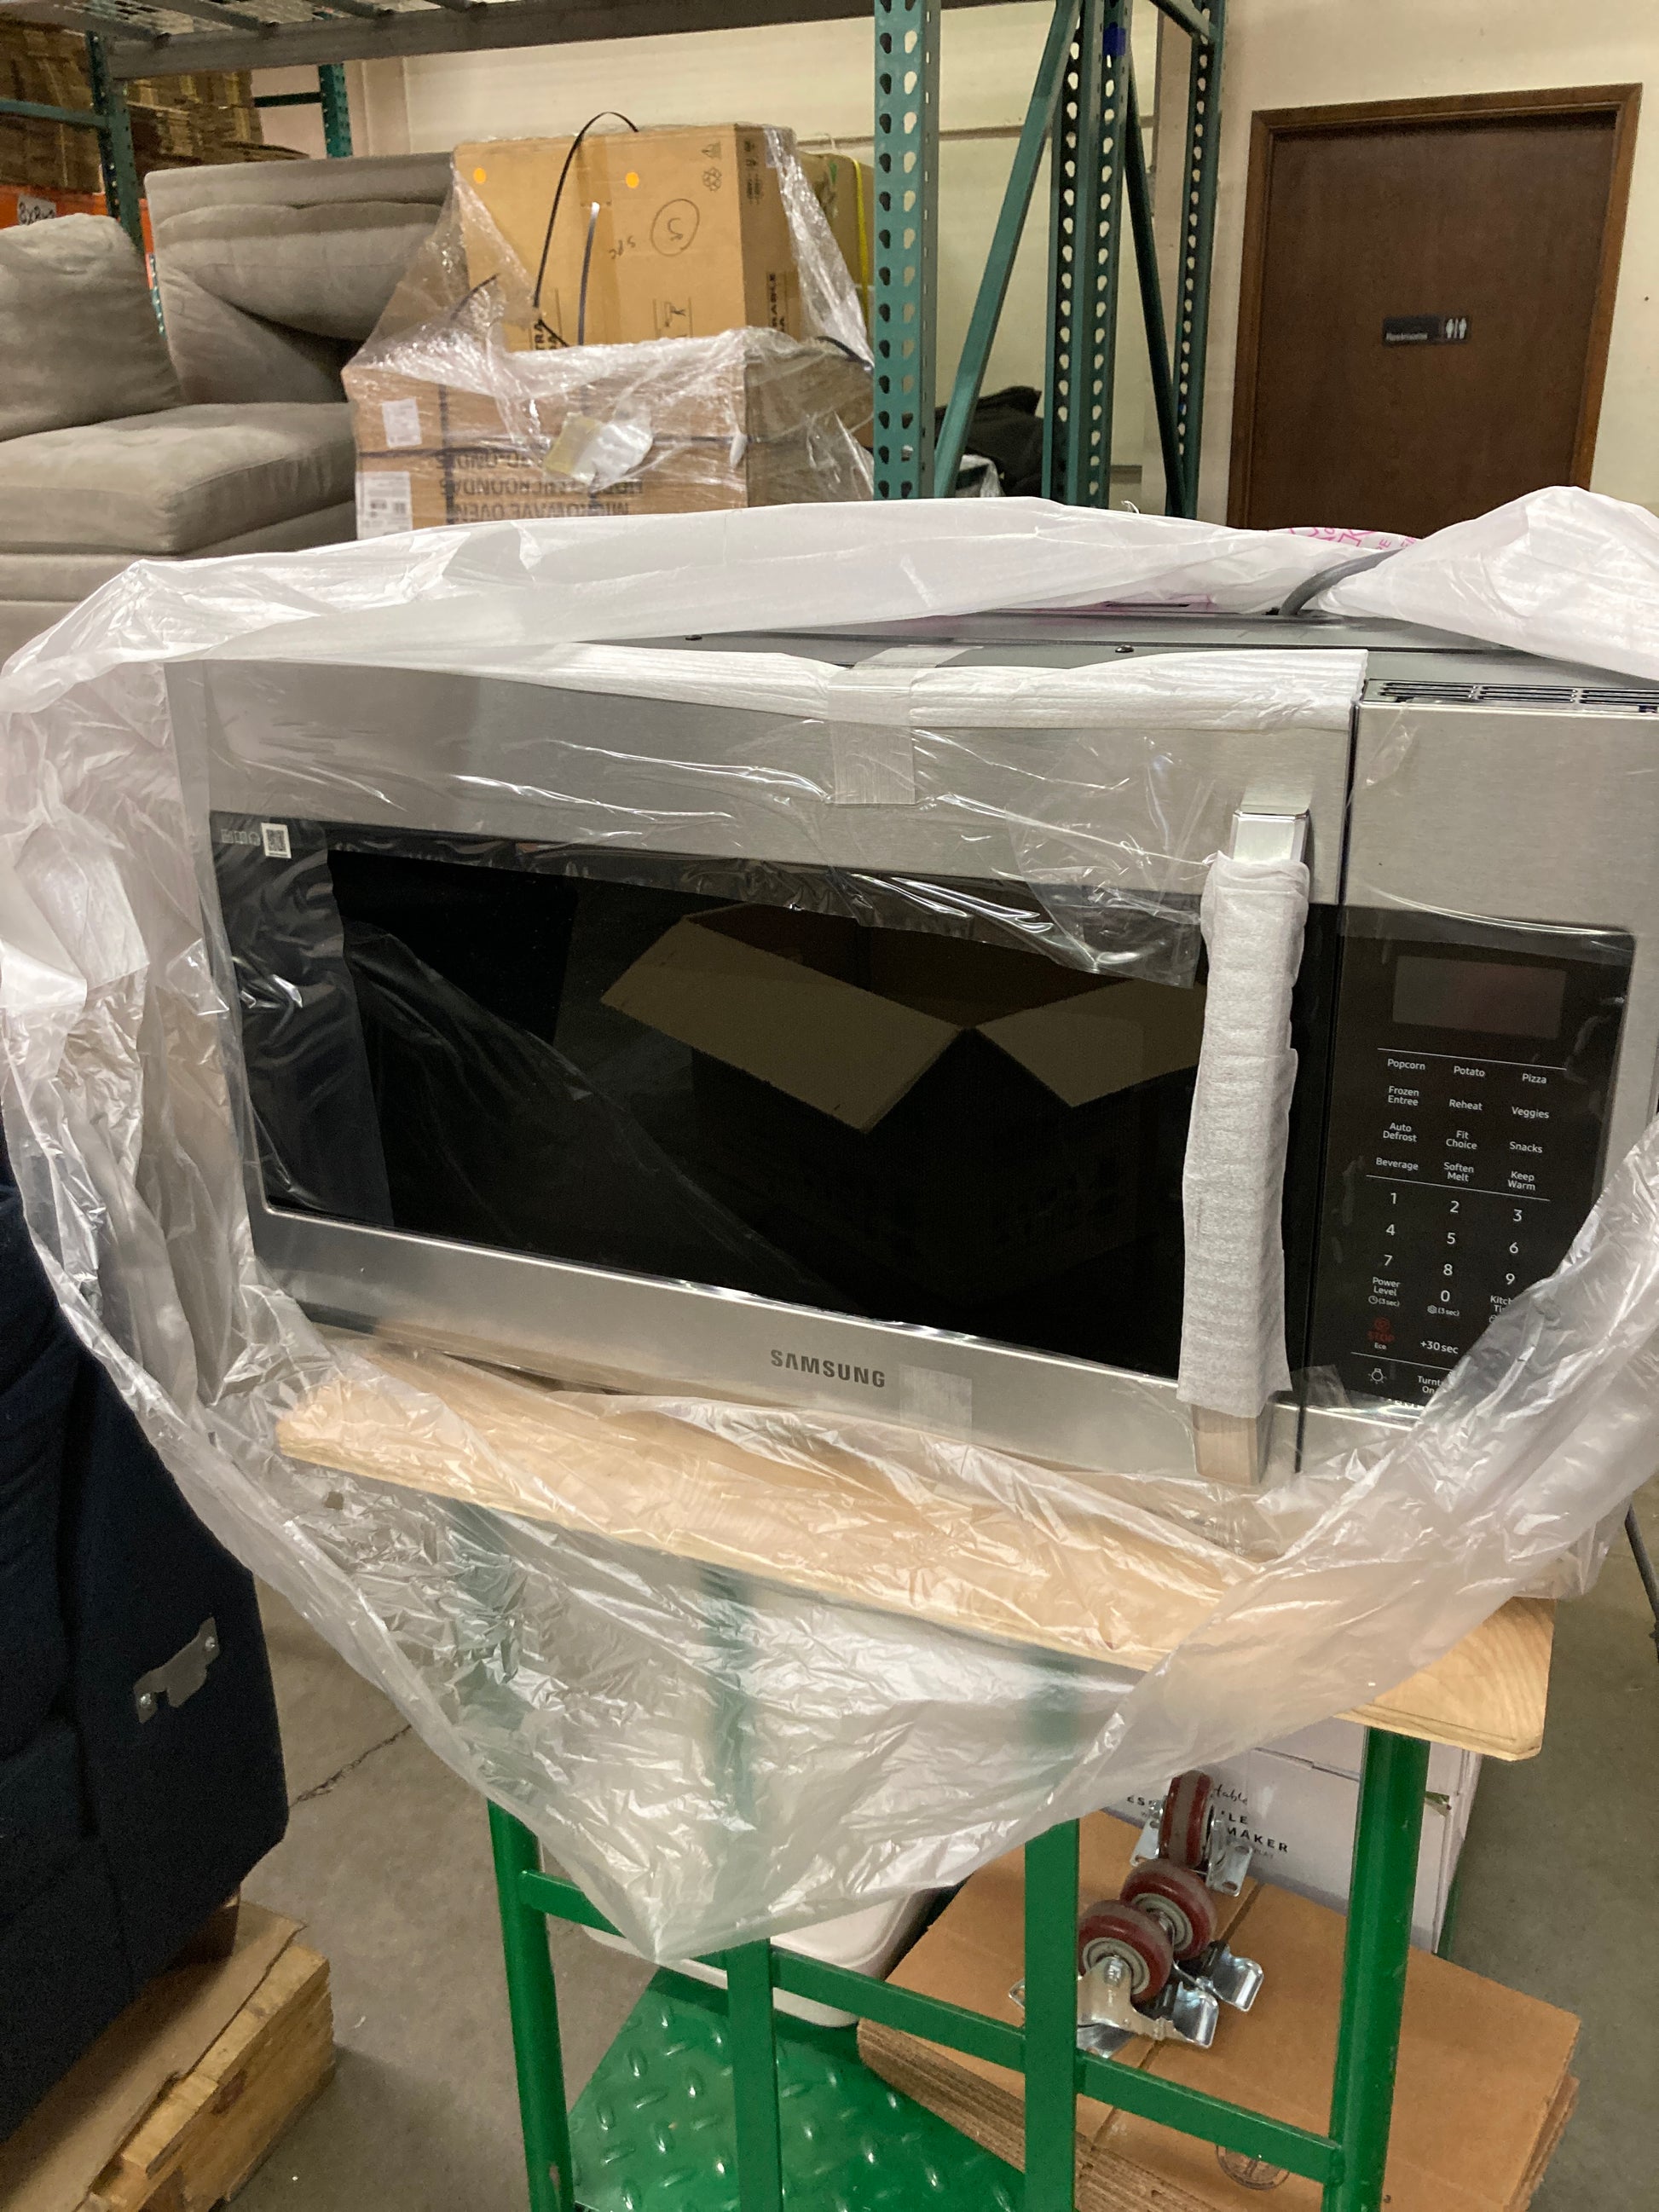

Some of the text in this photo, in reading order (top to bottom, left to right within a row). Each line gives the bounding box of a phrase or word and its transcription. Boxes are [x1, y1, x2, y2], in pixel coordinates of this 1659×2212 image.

[1387, 1058, 1425, 1071] Popcorn
[1453, 1066, 1485, 1077] Potato
[1522, 1073, 1547, 1084] Pizza
[1388, 1085, 1419, 1097] Frozen
[1387, 1094, 1419, 1106] Entree
[1448, 1099, 1483, 1111] Reheat
[1512, 1106, 1550, 1119] Veggies
[1389, 1122, 1412, 1133] Auto
[1383, 1130, 1417, 1142] Defrost
[1456, 1130, 1469, 1140] Fit
[1446, 1138, 1477, 1150] Choice
[1509, 1141, 1542, 1153] Snacks
[1376, 1158, 1419, 1171] Beverage
[1443, 1162, 1474, 1174] Soften
[1447, 1172, 1470, 1182] Melt
[1511, 1170, 1535, 1181] Keep
[1507, 1180, 1535, 1190] Warm
[1390, 1192, 1396, 1204] 1
[1449, 1200, 1460, 1214] 2
[1512, 1209, 1523, 1222] 3
[1385, 1223, 1396, 1236] 4
[1446, 1232, 1456, 1245] 5
[1509, 1241, 1519, 1254] 6
[1384, 1254, 1393, 1266] 7
[1442, 1263, 1454, 1276] 8
[1372, 1276, 1401, 1288] Power
[1506, 1273, 1516, 1285] 9
[1373, 1285, 1397, 1297] Level
[1440, 1290, 1451, 1302] 0
[1420, 1340, 1460, 1354] +30 sec
[770, 1349, 885, 1389] SAMSUNG
[1417, 1375, 1442, 1387] Turnt
